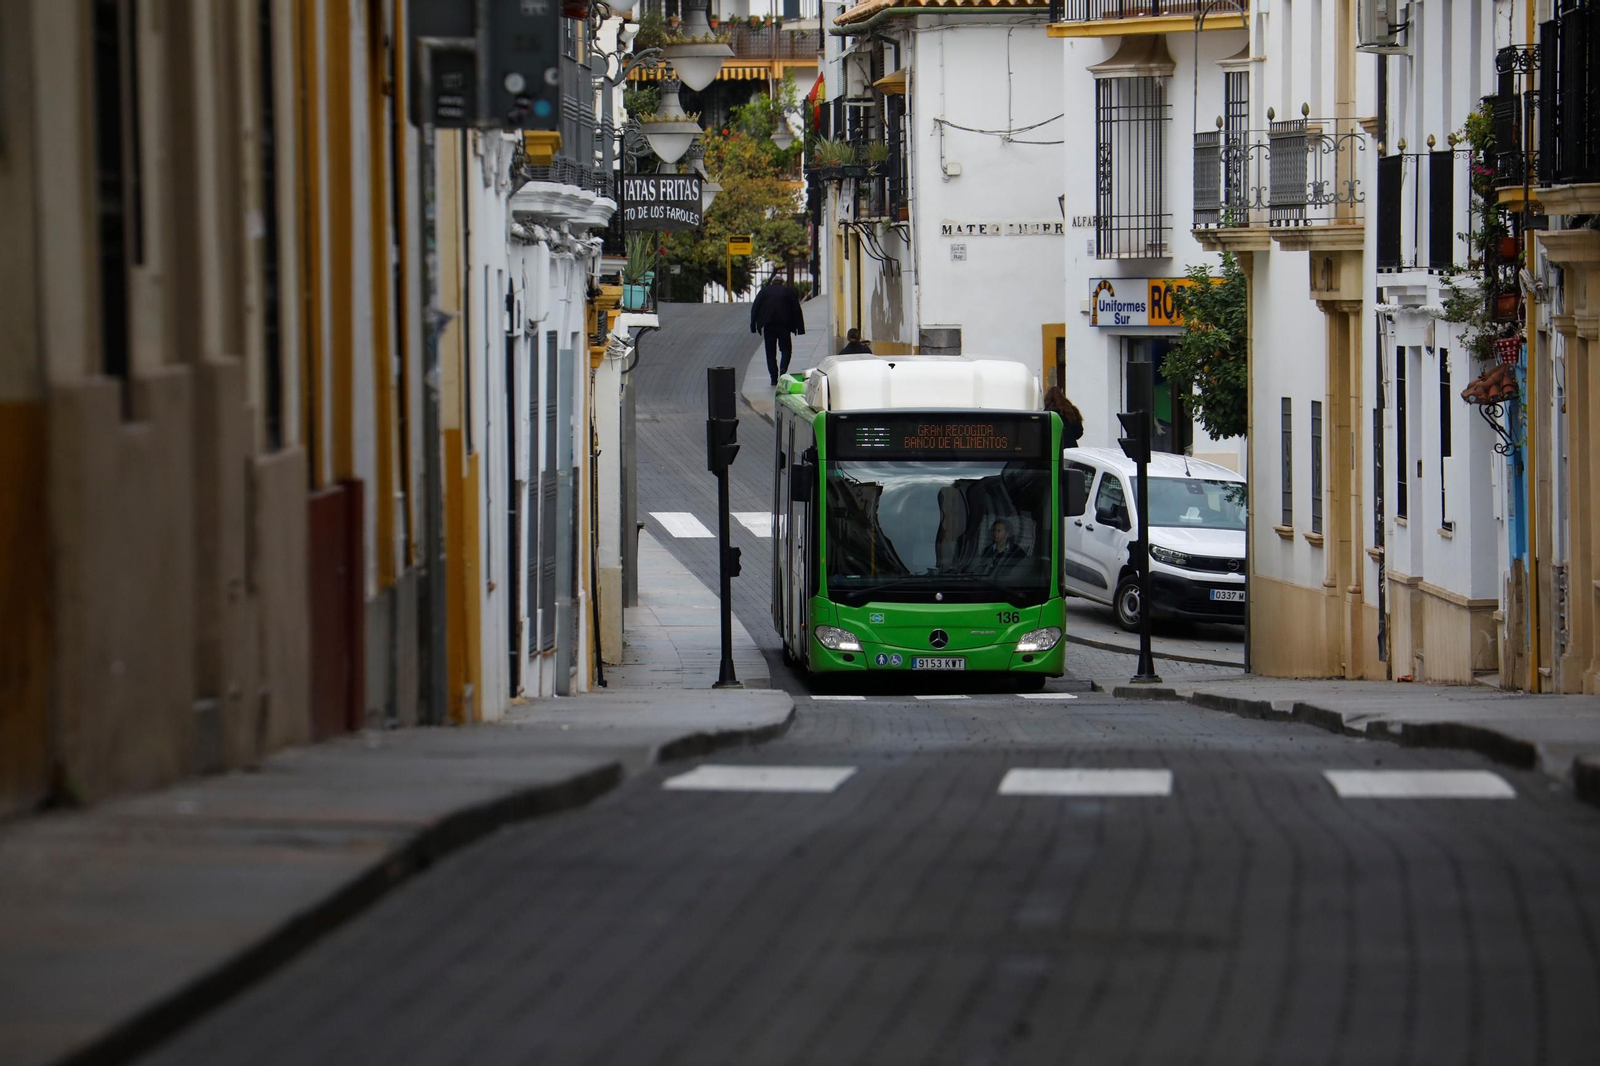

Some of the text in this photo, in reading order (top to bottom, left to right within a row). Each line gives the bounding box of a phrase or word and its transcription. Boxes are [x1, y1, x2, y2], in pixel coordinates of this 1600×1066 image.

[618, 179, 699, 201] TATAS FRITAS
[624, 205, 699, 226] TO DE LOS FAROLES
[1098, 300, 1146, 312] Uniformes
[1114, 312, 1130, 325] Sur
[917, 424, 994, 436] GRAN RECOGIDA
[904, 437, 1008, 448] BANCO DE ALIMENTOS
[1215, 590, 1237, 599] 0337
[996, 611, 1020, 624] 136
[918, 658, 942, 668] 9153
